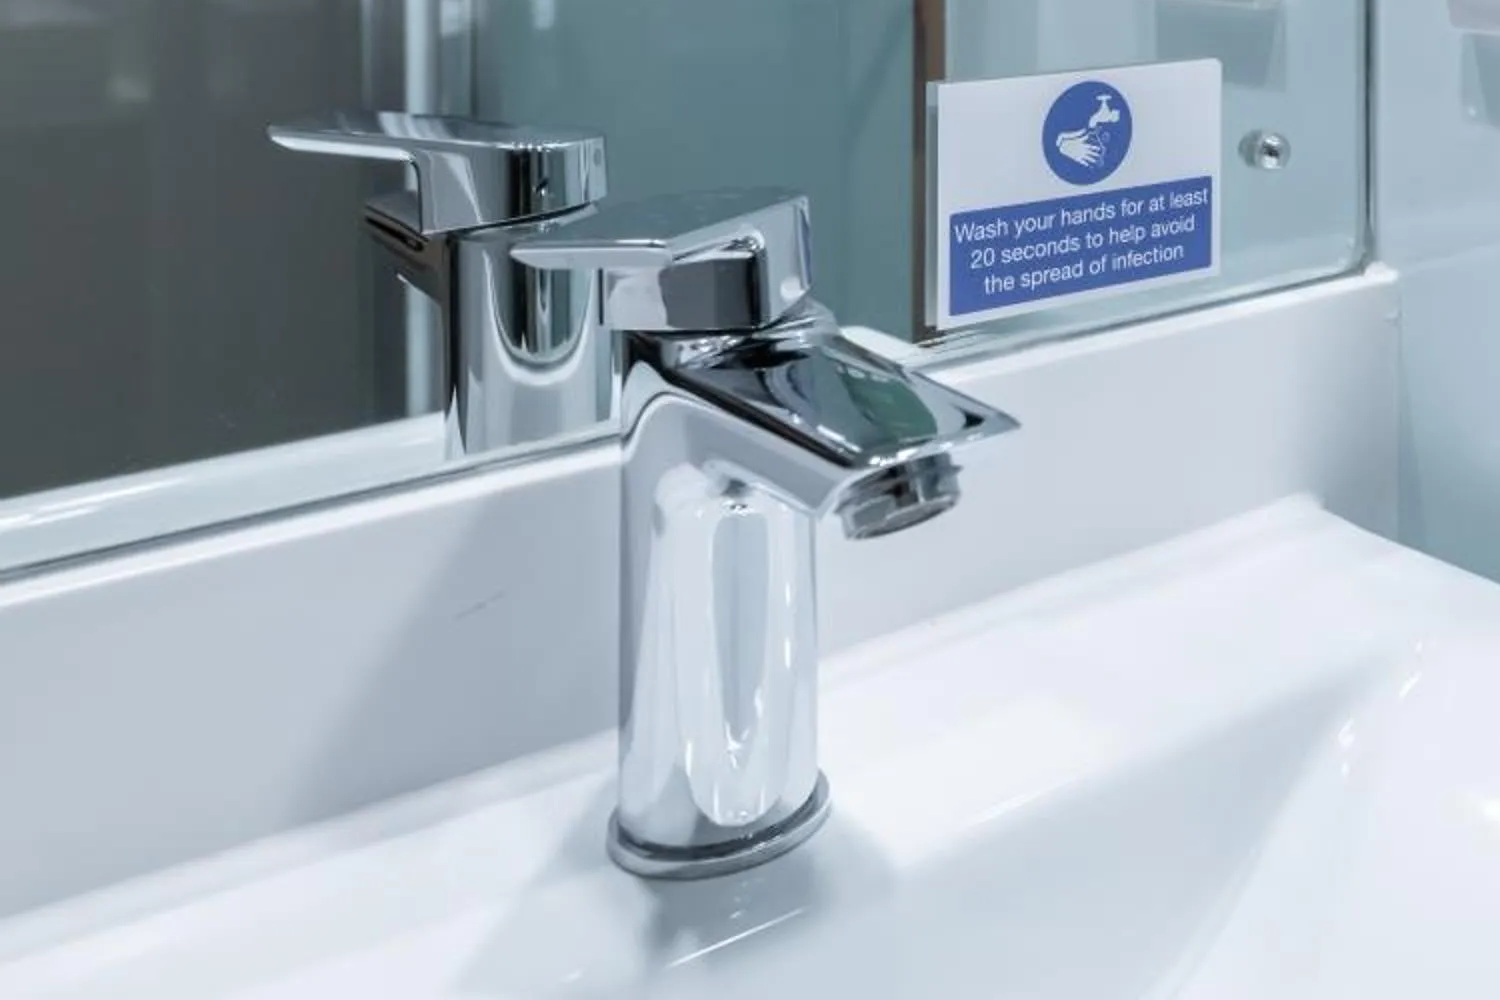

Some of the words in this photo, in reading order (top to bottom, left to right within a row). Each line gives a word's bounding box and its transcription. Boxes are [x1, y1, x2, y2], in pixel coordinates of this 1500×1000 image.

[954, 220, 1008, 244] Wash
[1013, 214, 1055, 239] your
[1061, 205, 1116, 226] hands
[1121, 198, 1143, 216] for
[1149, 194, 1166, 212] at
[1170, 188, 1210, 209] least
[970, 248, 995, 269] 20
[1001, 234, 1081, 265] seconds
[1086, 232, 1104, 248] to
[1109, 224, 1146, 244] help
[1151, 214, 1195, 238] avoid
[984, 273, 1015, 295] the
[1020, 260, 1083, 290] spread
[1089, 257, 1108, 274] of
[1112, 244, 1184, 271] infection
